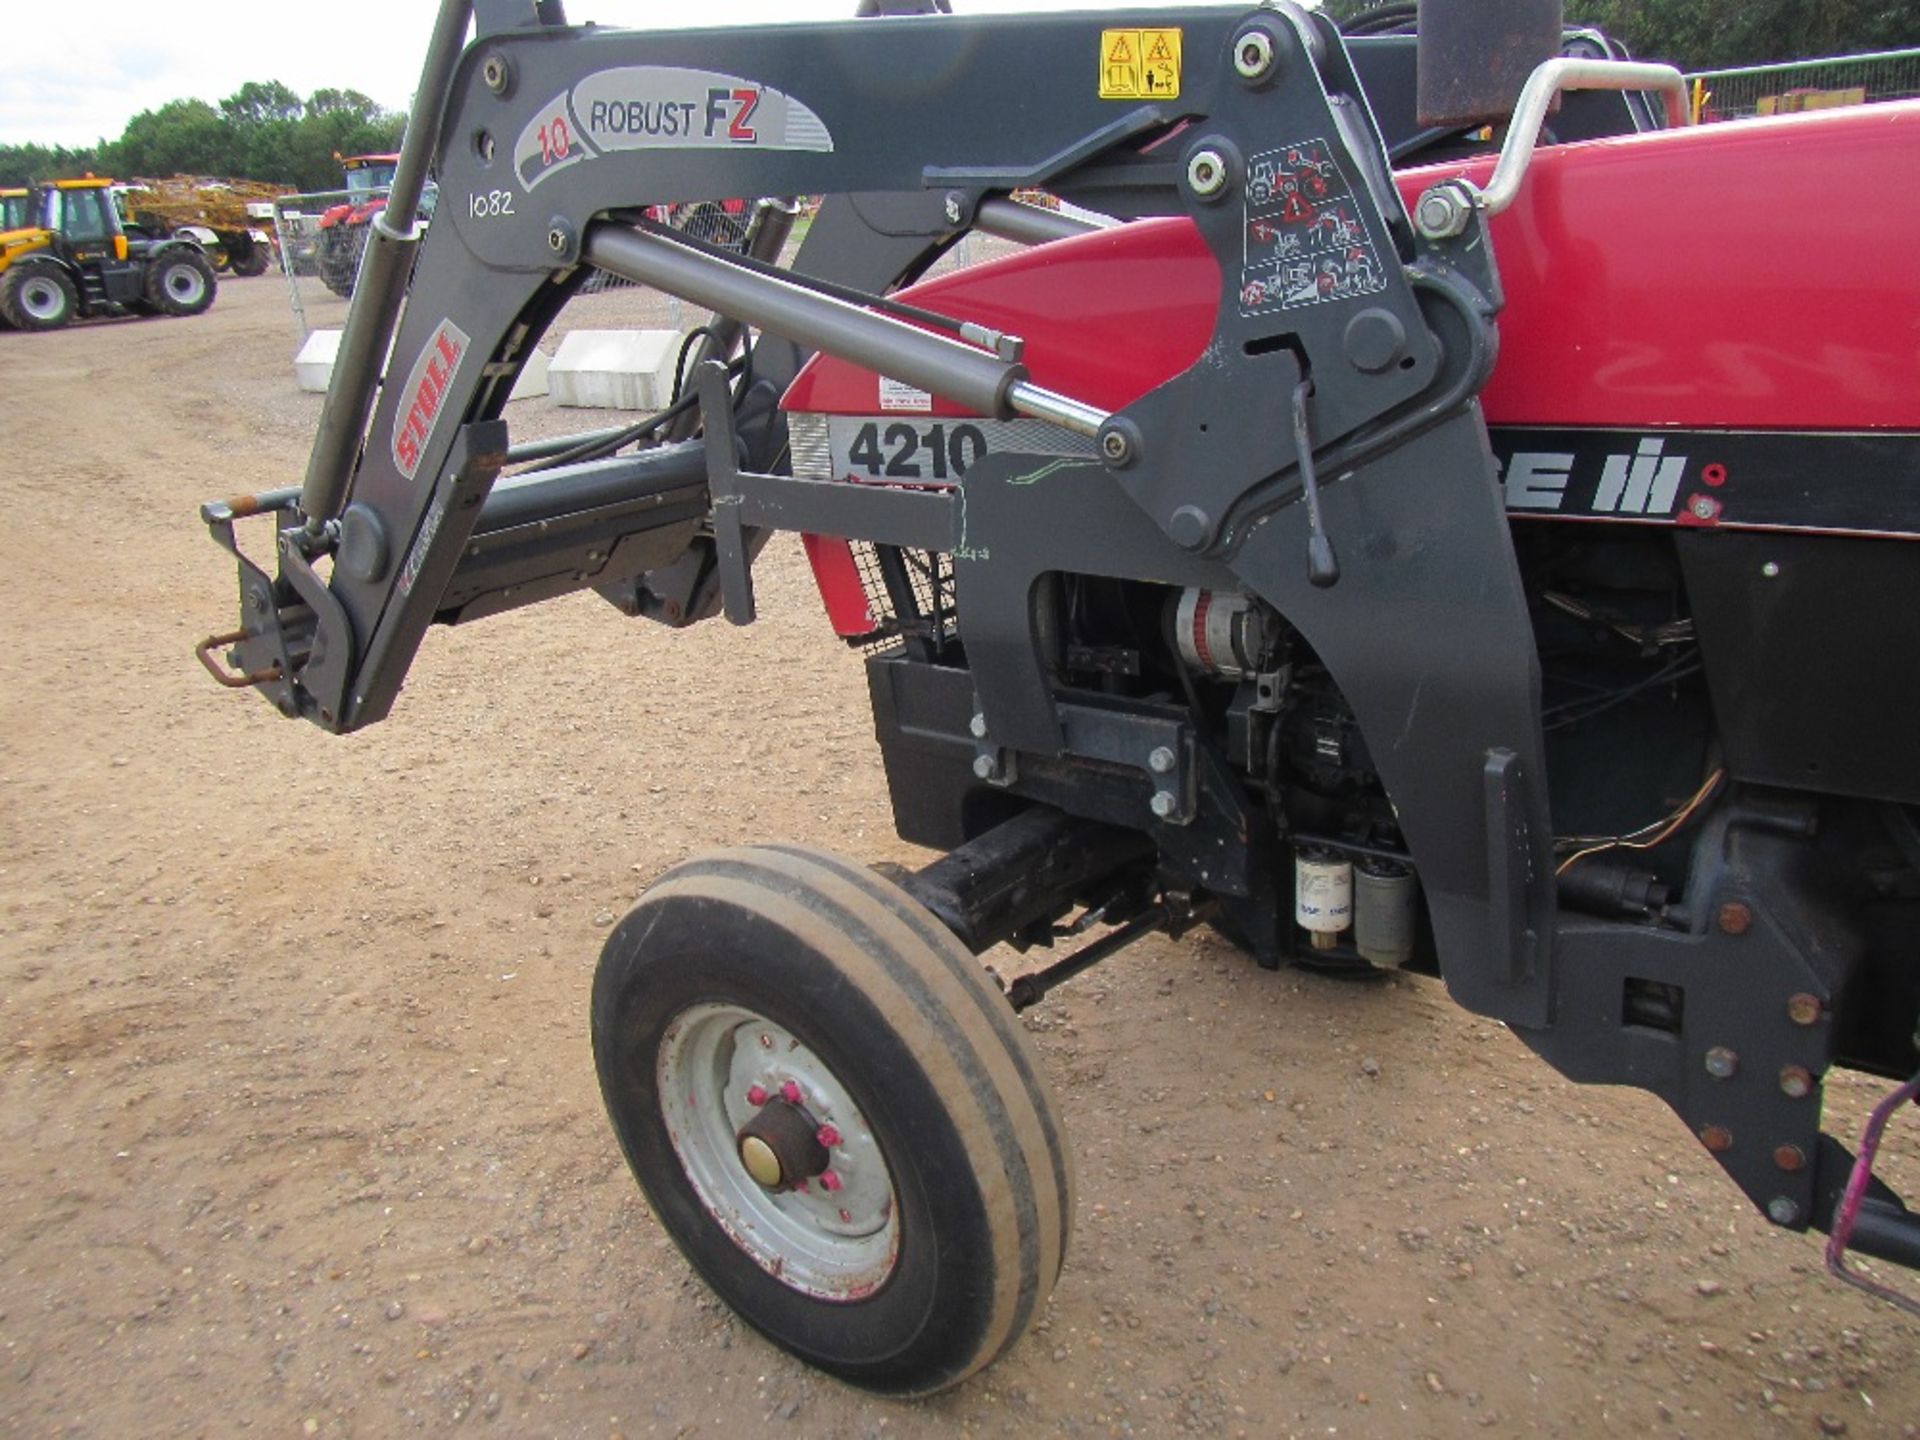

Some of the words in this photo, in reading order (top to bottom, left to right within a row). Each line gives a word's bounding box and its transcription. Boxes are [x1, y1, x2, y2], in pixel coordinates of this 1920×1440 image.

[538, 116, 570, 164] 10
[591, 101, 696, 137] ROBUST
[704, 88, 758, 142] FZ
[469, 190, 515, 218] 1082
[396, 329, 461, 471] STOLL
[850, 422, 988, 478] 4210
